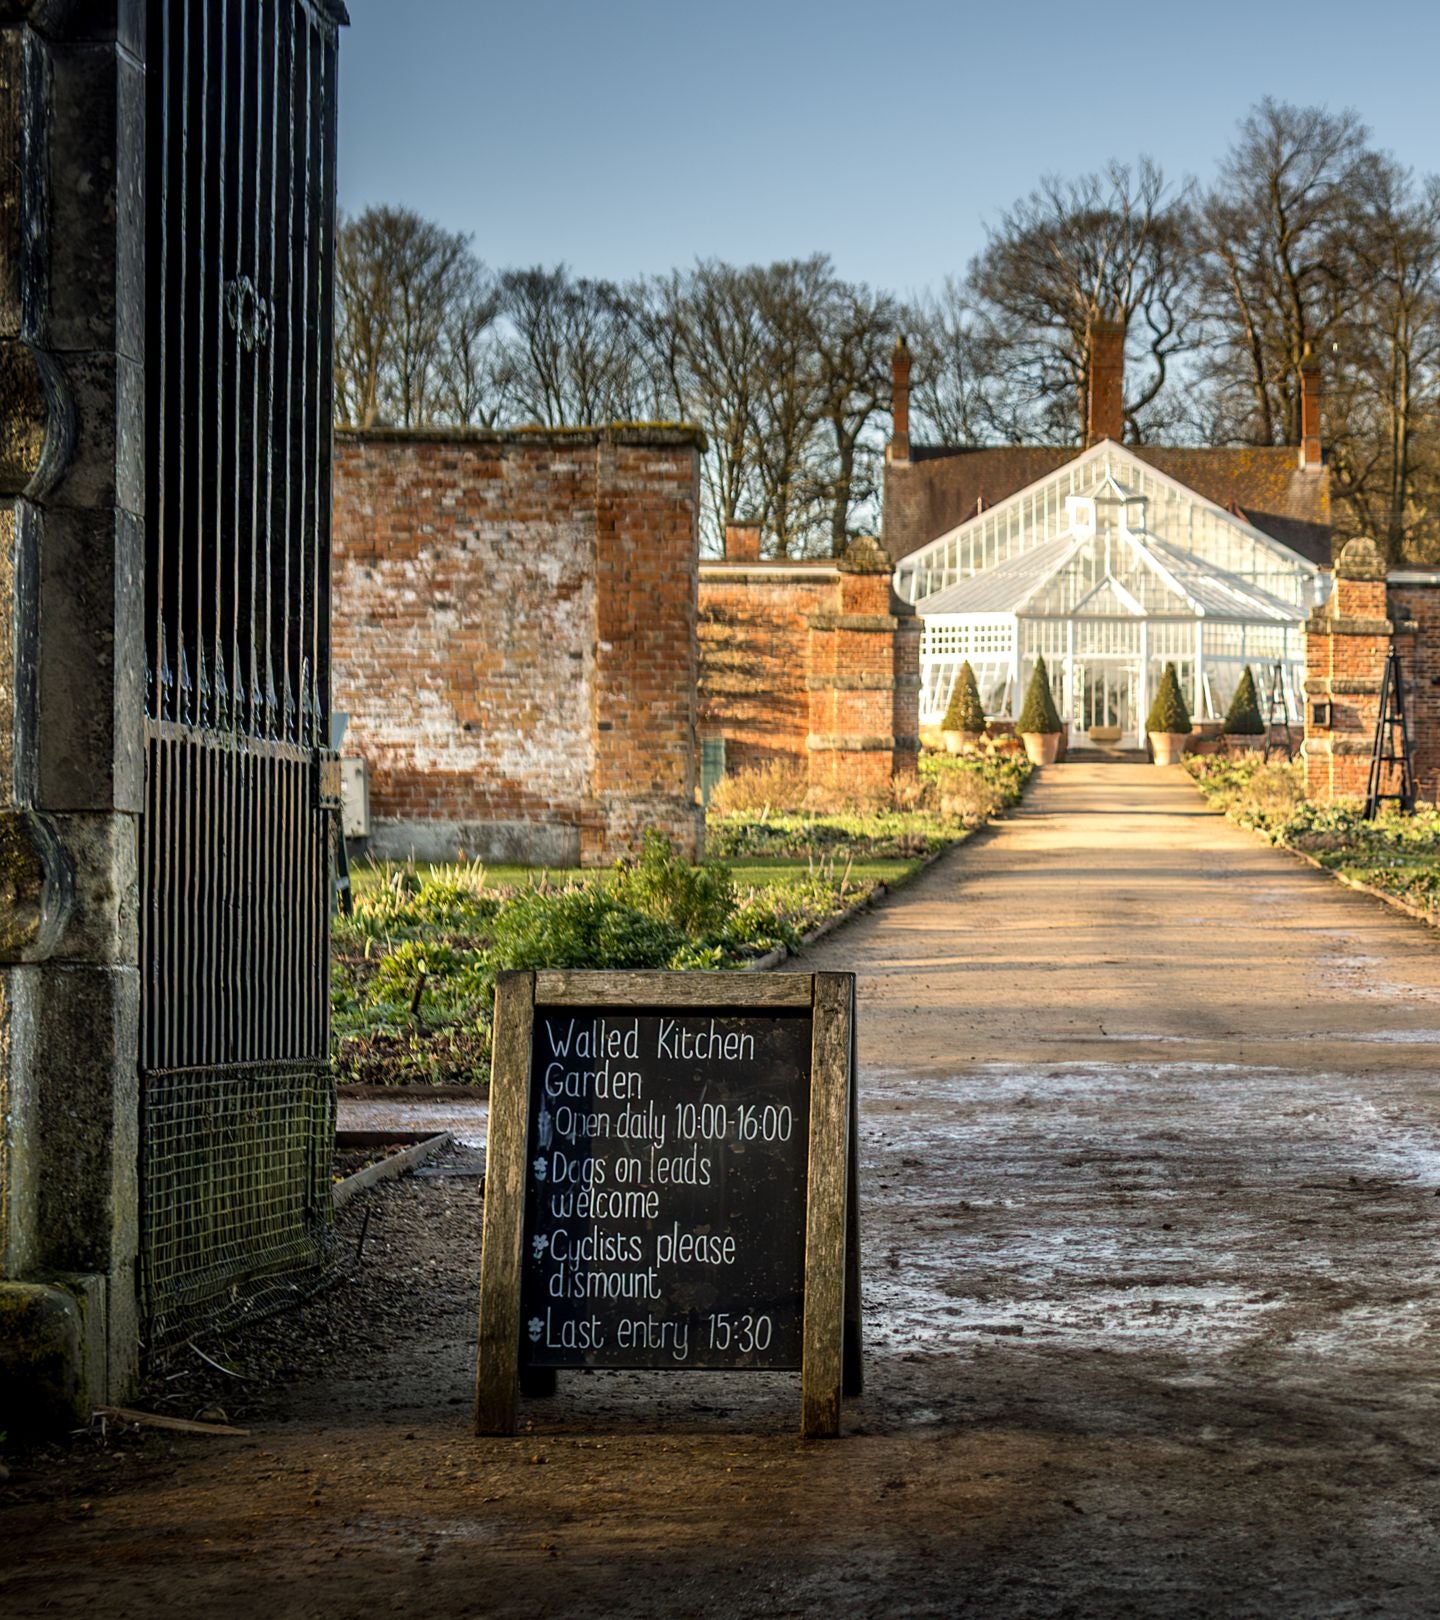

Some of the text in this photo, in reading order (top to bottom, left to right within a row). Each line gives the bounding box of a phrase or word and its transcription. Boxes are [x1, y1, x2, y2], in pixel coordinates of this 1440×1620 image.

[545, 1018, 755, 1060] Walled Kitchen
[544, 1060, 643, 1099] Garden
[554, 1100, 793, 1149] Open daily 10:00-16:00
[552, 1142, 712, 1191] Dogs on leads
[551, 1188, 660, 1219] welcome
[550, 1221, 736, 1271] Cyclists please
[550, 1263, 662, 1299] dismount
[546, 1306, 773, 1361] Last entry 15:30
